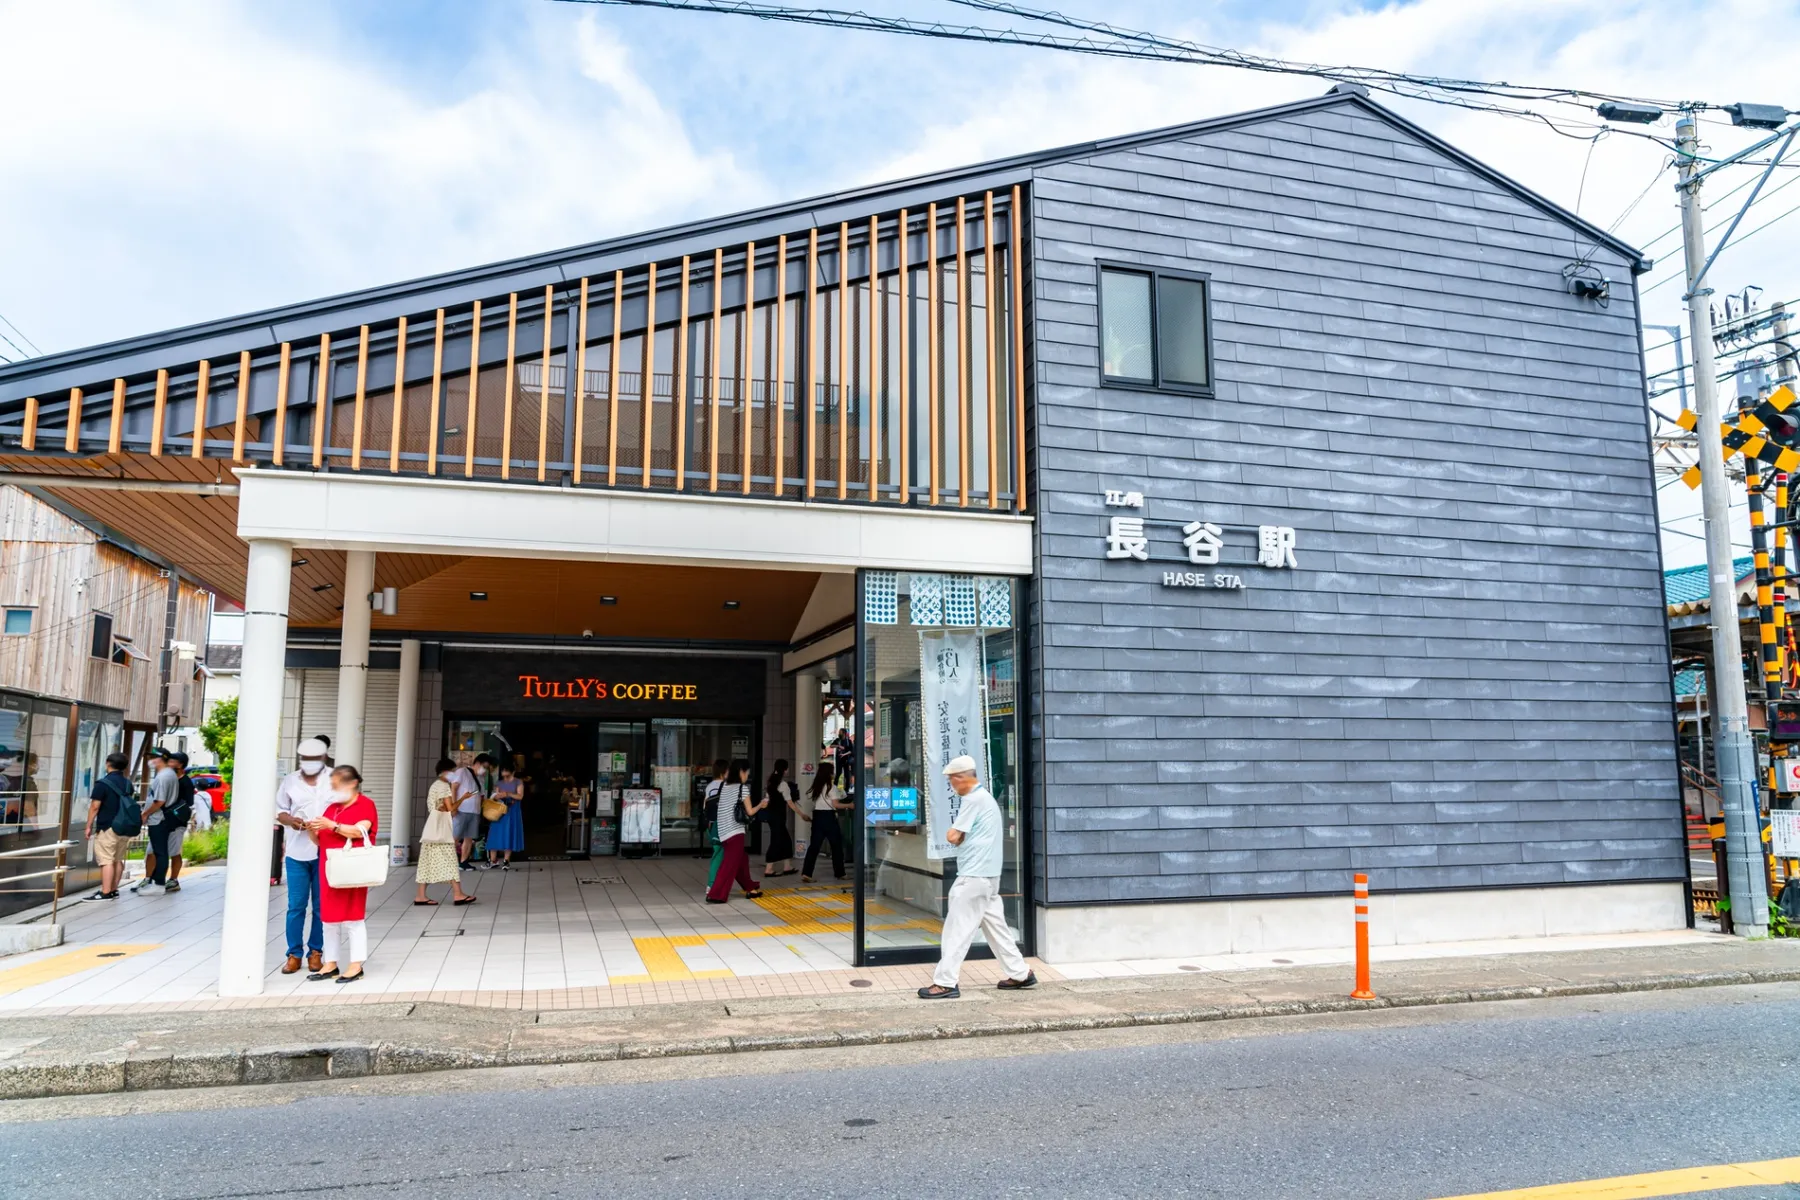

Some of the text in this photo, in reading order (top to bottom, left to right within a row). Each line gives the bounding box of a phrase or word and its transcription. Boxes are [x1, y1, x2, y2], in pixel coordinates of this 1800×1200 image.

[1106, 516, 1298, 569] 長谷駅
[1163, 572, 1247, 589] HASE STA.
[612, 683, 697, 700] COFFEE
[866, 790, 889, 800] 長谷寺
[868, 799, 887, 808] 大仏
